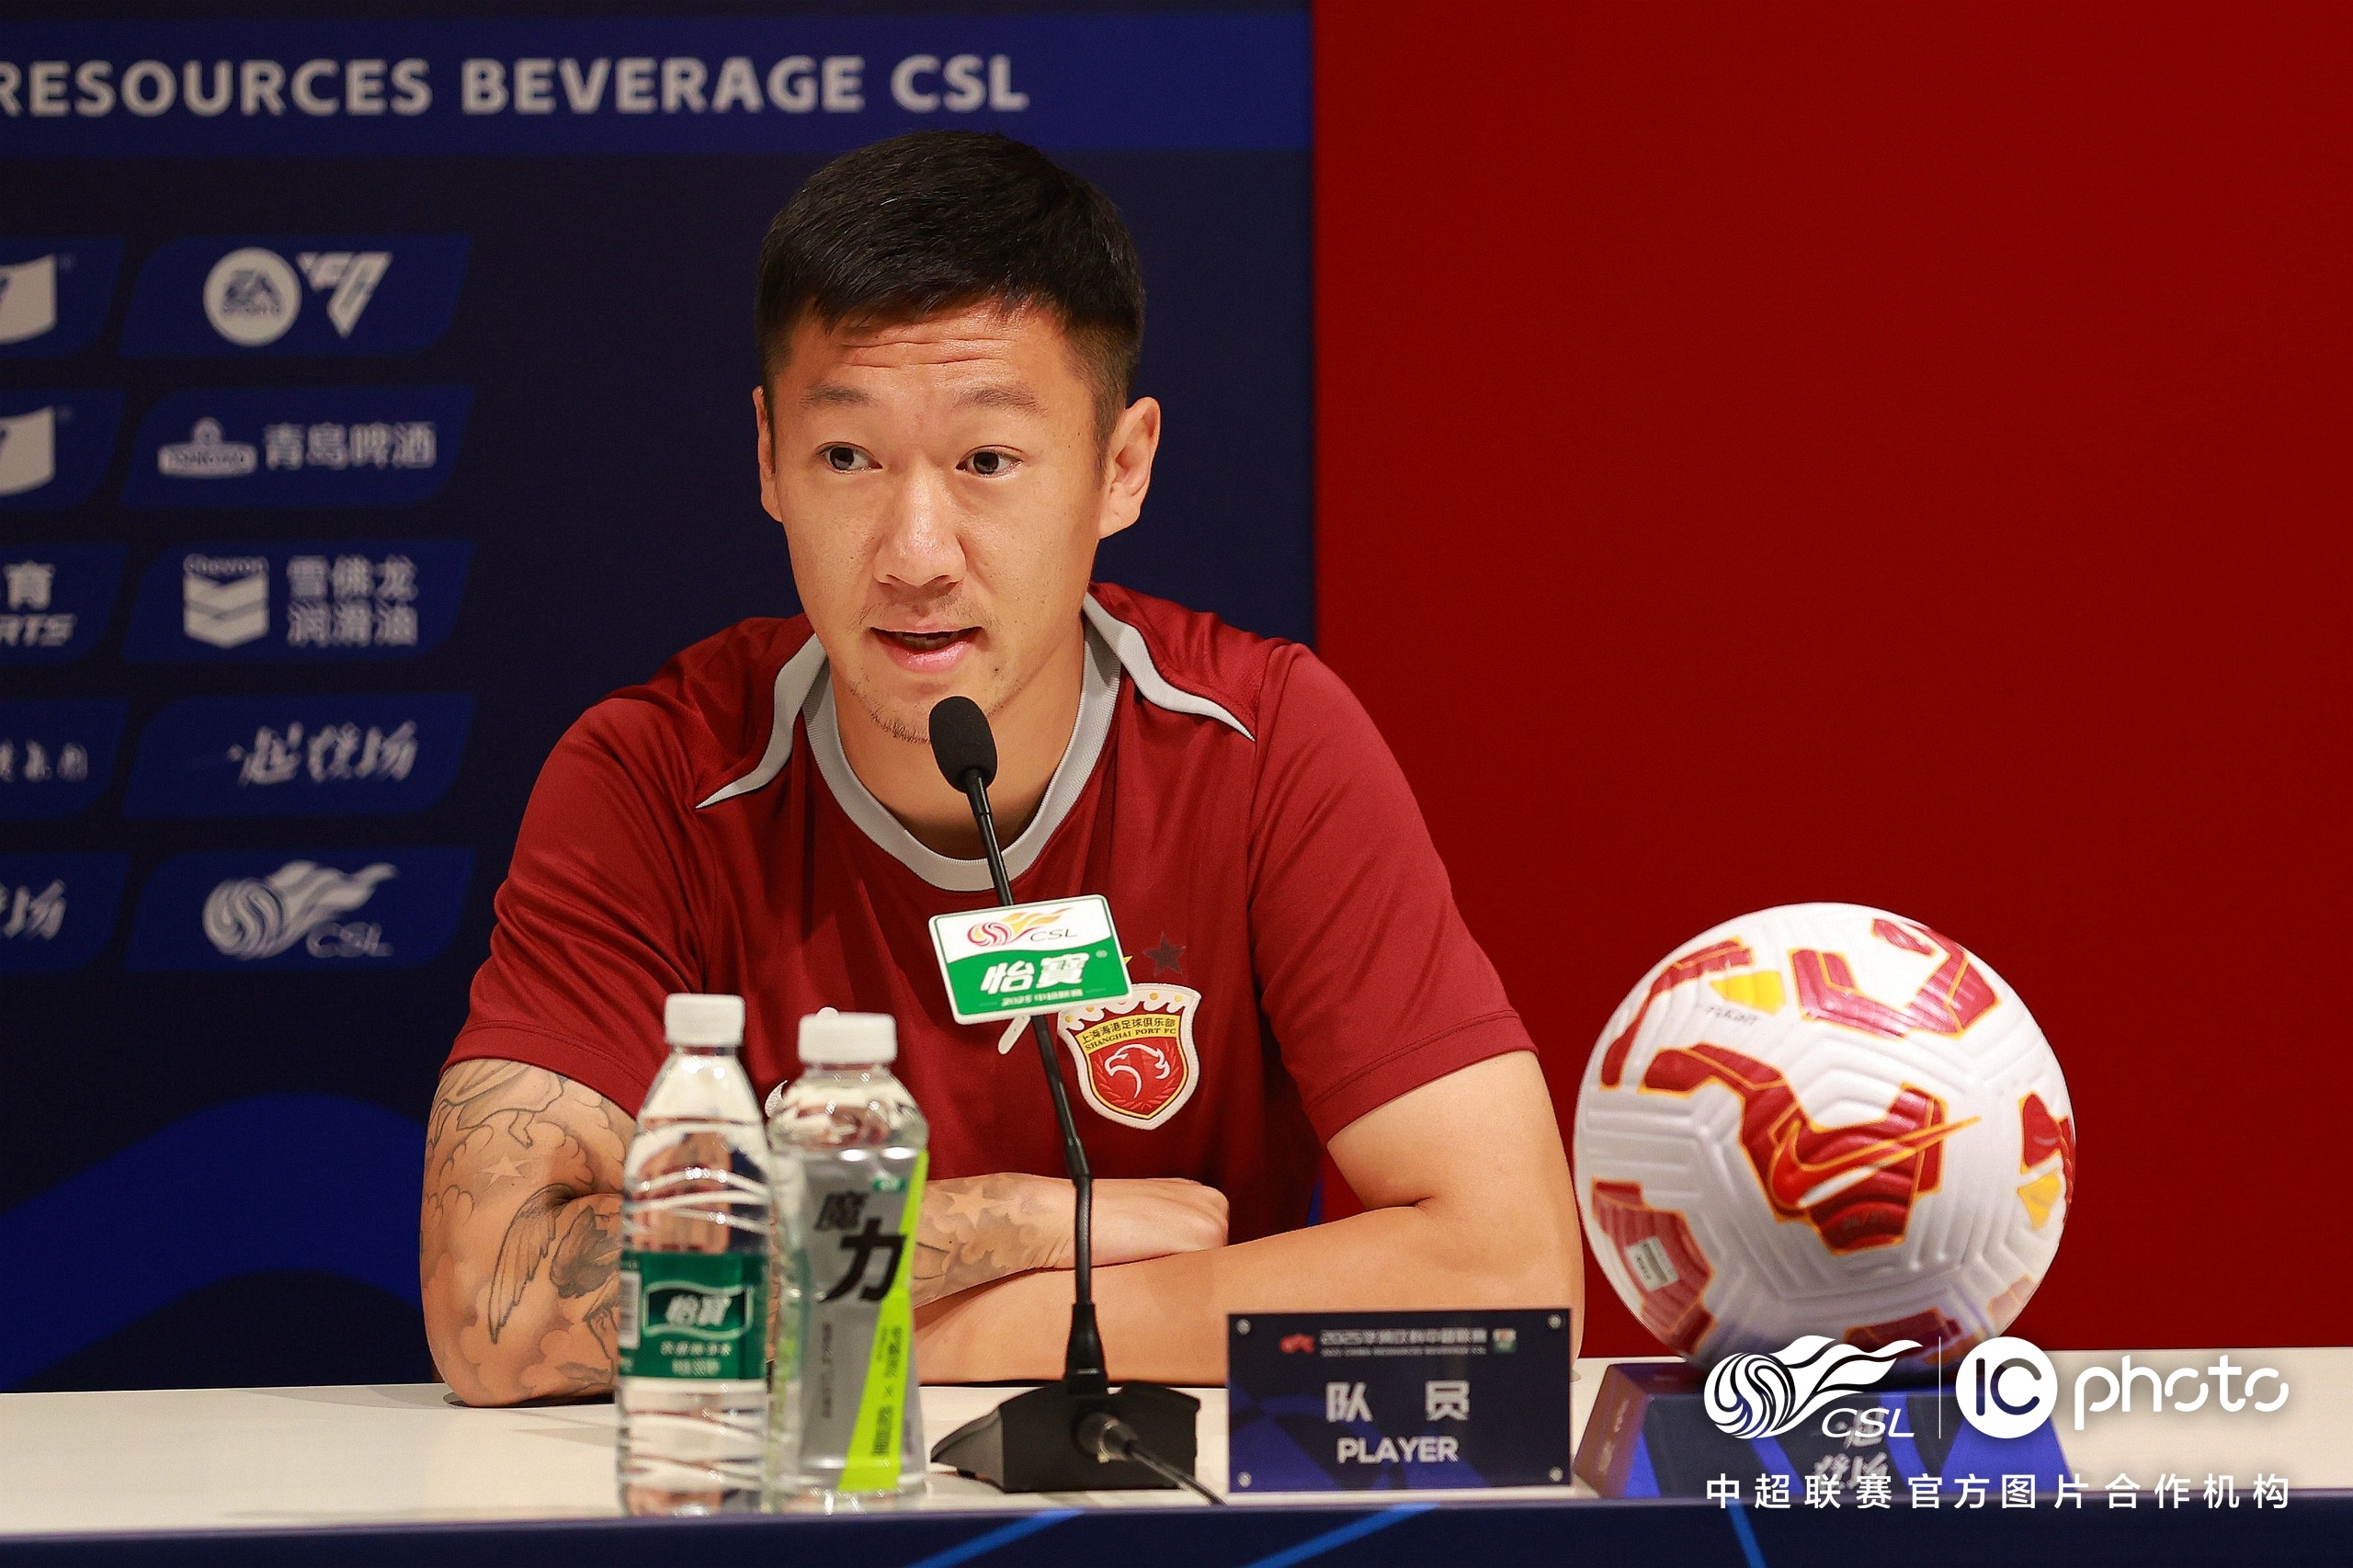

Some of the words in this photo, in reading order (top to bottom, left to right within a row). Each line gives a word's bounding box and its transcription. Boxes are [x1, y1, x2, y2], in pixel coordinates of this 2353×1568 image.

[460, 55, 866, 115] BEVERAGE
[890, 53, 1030, 113] CSL
[1030, 928, 1078, 942] CSL
[1086, 1030, 1131, 1051] SHANGHAI
[1135, 1028, 1160, 1036] PORT
[1325, 1381, 1470, 1423] 队员
[1337, 1436, 1460, 1464] PLAYER
